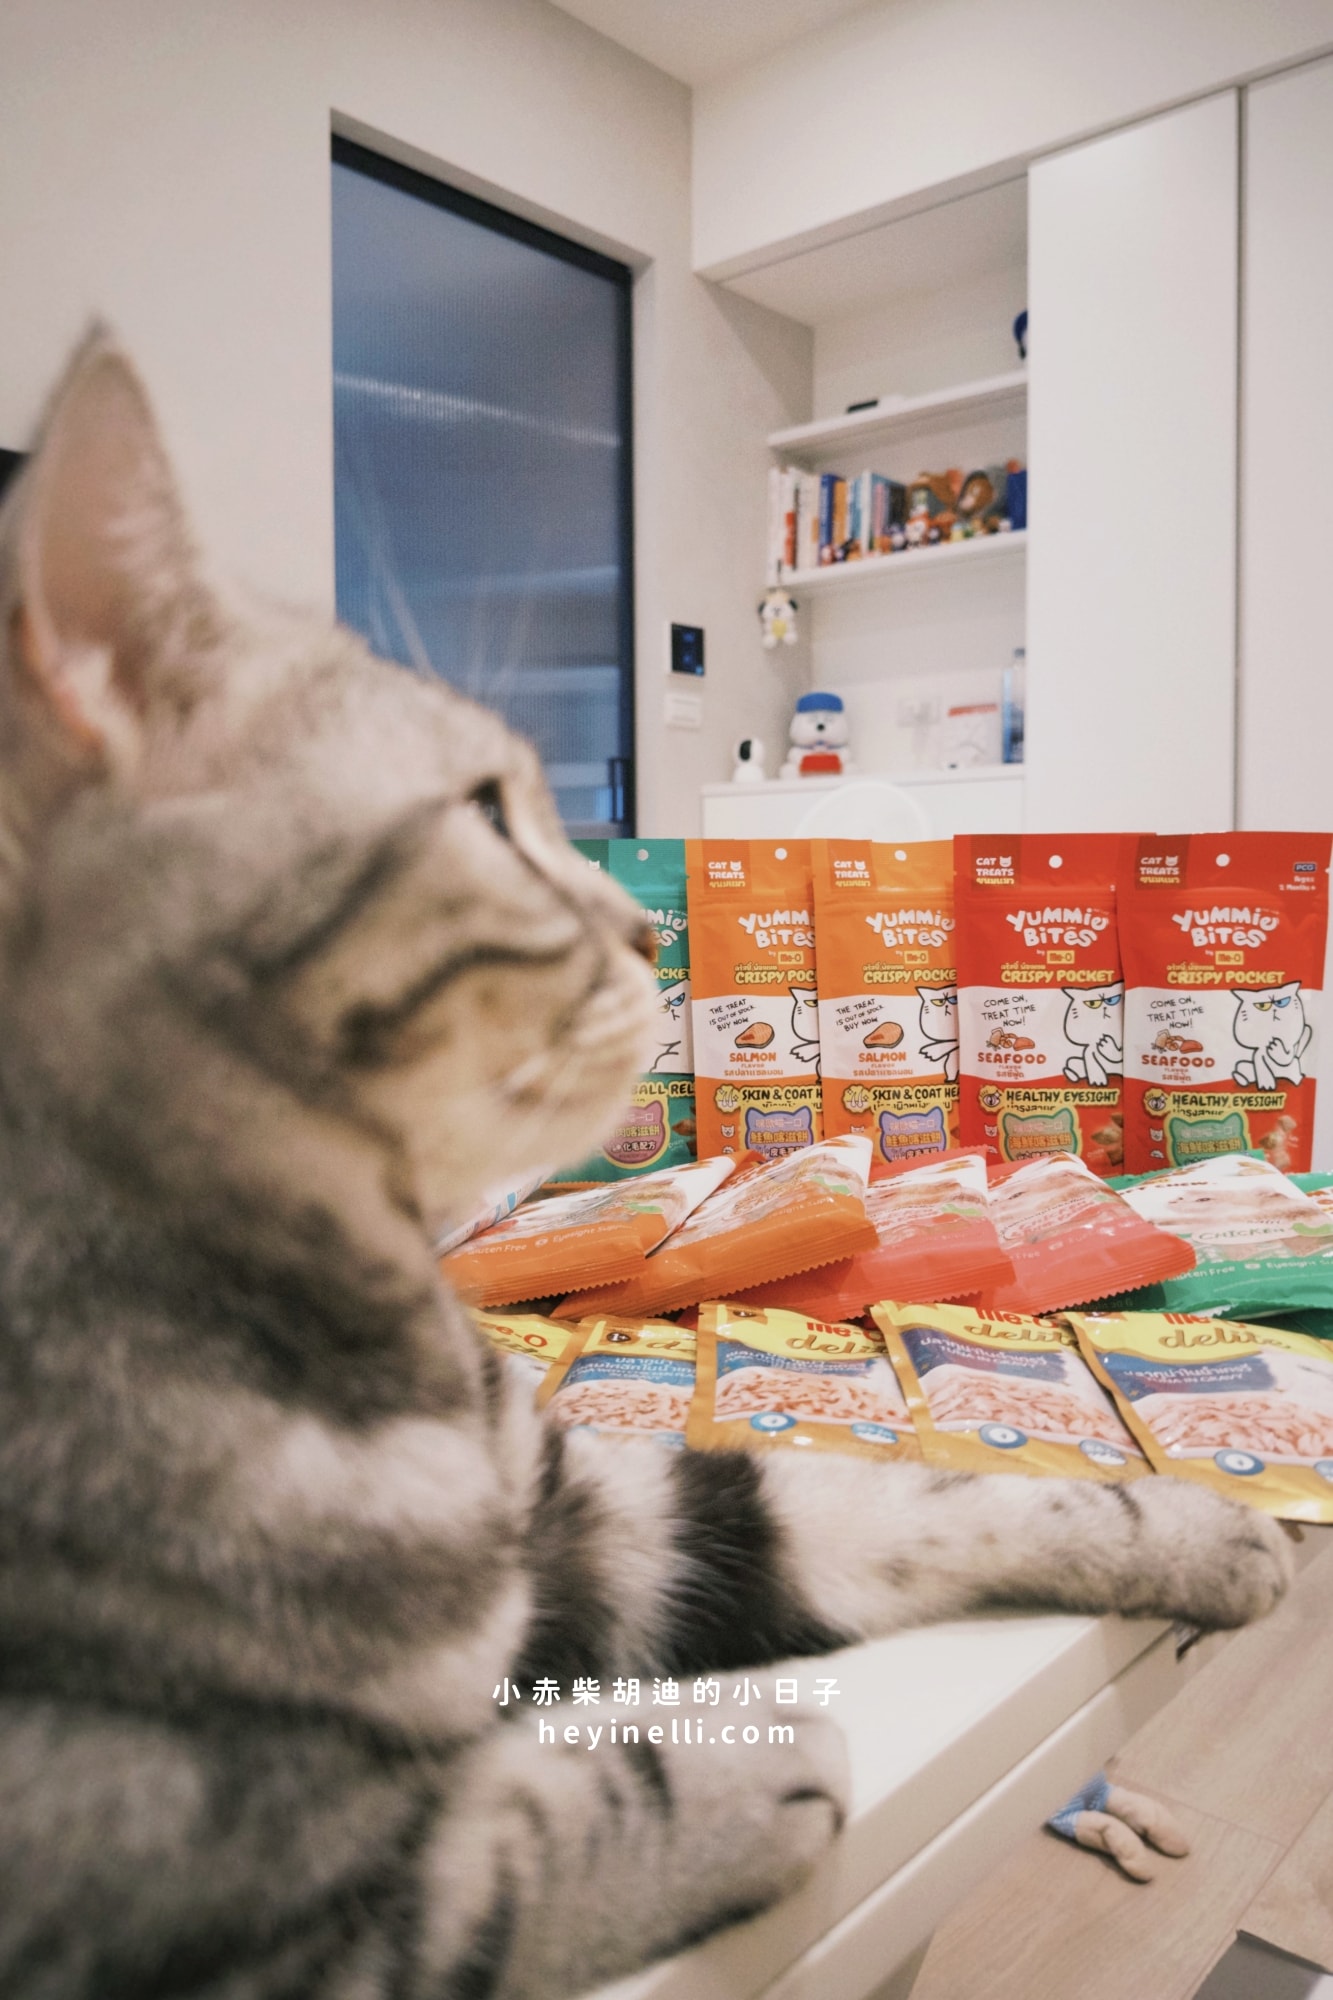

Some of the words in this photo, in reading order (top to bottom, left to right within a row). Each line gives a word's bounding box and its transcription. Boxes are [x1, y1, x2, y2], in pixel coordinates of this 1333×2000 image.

[708, 861, 728, 870] CAT
[834, 860, 852, 868] CAT
[976, 858, 996, 866] CAT
[708, 871, 745, 880] TREATS
[834, 870, 870, 878] TREATS
[976, 868, 1014, 876] TREATS
[1139, 867, 1180, 875] TREATS
[736, 971, 786, 984] CRISPY
[864, 970, 912, 984] CRISPY
[1002, 970, 1054, 983] CRISPY
[1056, 970, 1114, 982] POCKET
[1167, 971, 1223, 984] CRISPY
[1225, 970, 1285, 984] POCKET
[709, 1006, 724, 1014] THE
[726, 998, 747, 1011] TREAT
[836, 1006, 850, 1015] THE
[854, 998, 876, 1010] TREAT
[984, 996, 1010, 1008] COME
[1150, 998, 1176, 1009] COME
[981, 1008, 1009, 1021] TREAT
[1014, 1004, 1036, 1016] TIME
[1147, 1010, 1176, 1022] TREAT
[1181, 1006, 1204, 1018] TIME
[716, 1023, 732, 1032] BUY
[733, 1016, 749, 1026] NOW
[844, 1023, 859, 1032] BUY
[861, 1017, 878, 1026] NOW
[1002, 1016, 1026, 1028] NOW!
[1169, 1018, 1193, 1029] NOW!
[729, 1052, 776, 1062] SALMON
[858, 1052, 906, 1062] SALMON
[978, 1052, 1046, 1064] SEAFOOD
[1141, 1054, 1216, 1068] SEAFOOD
[742, 1089, 770, 1100] SKIN
[772, 1088, 782, 1100] &
[784, 1088, 812, 1100] COAT
[872, 1089, 901, 1100] SKIN
[903, 1088, 913, 1100] &
[914, 1088, 942, 1100] COAT
[1006, 1090, 1060, 1102] HEALTHY
[1064, 1090, 1118, 1102] EYESIGHT
[1172, 1094, 1229, 1106] HEALTHY
[1232, 1094, 1284, 1106] EYESIGHT
[552, 1226, 596, 1243] Eyesight
[504, 1244, 528, 1252] Free
[1208, 1265, 1236, 1276] Free
[1266, 1259, 1316, 1270] Eyesight
